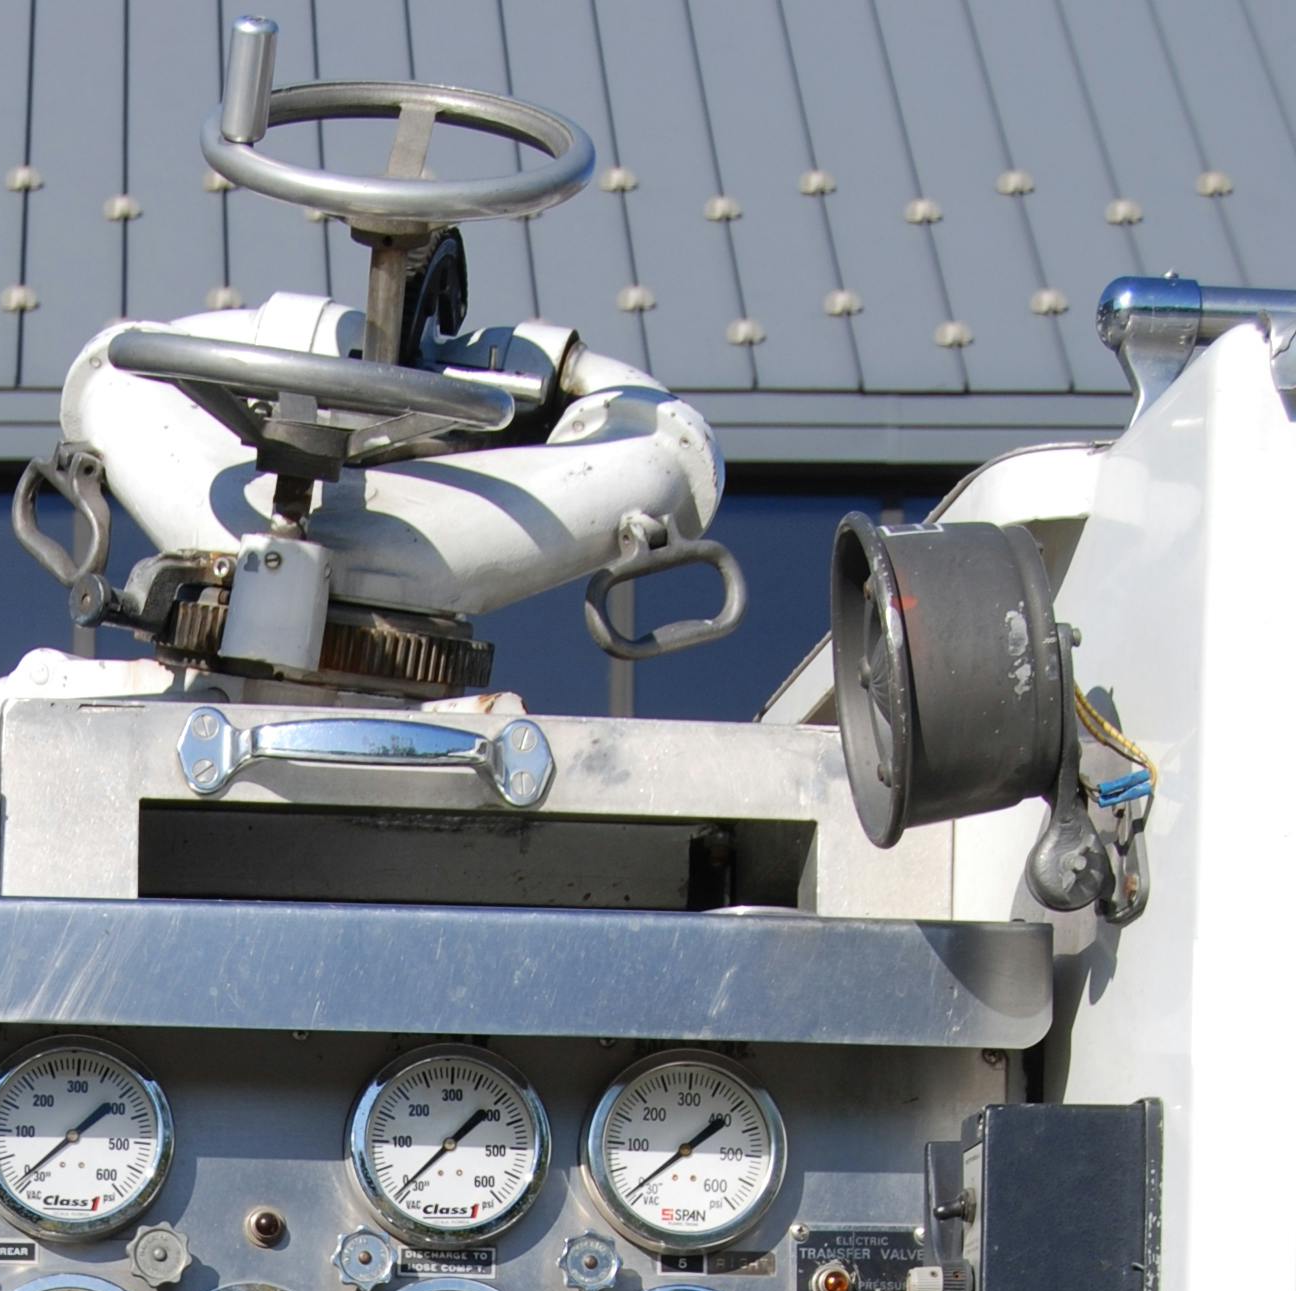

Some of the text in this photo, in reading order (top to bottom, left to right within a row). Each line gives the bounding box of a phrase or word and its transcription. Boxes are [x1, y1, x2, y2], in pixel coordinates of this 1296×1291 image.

[678, 1093, 700, 1106] 300
[643, 1108, 666, 1121] 200
[628, 1139, 648, 1151] 100
[720, 1148, 743, 1161] 500
[704, 1179, 727, 1192] 600
[27, 1191, 41, 1200] VAC
[406, 1201, 421, 1209] VAC
[643, 1197, 659, 1206] VAC
[675, 1210, 705, 1221] SPAN
[836, 1237, 888, 1245] ELECTRIC
[0, 1247, 28, 1256] REAR
[405, 1250, 488, 1260] DISCHARGE TO
[800, 1248, 924, 1260] TRANSFER VALVE
[408, 1264, 438, 1272] HOSE
[678, 1258, 687, 1268] 5
